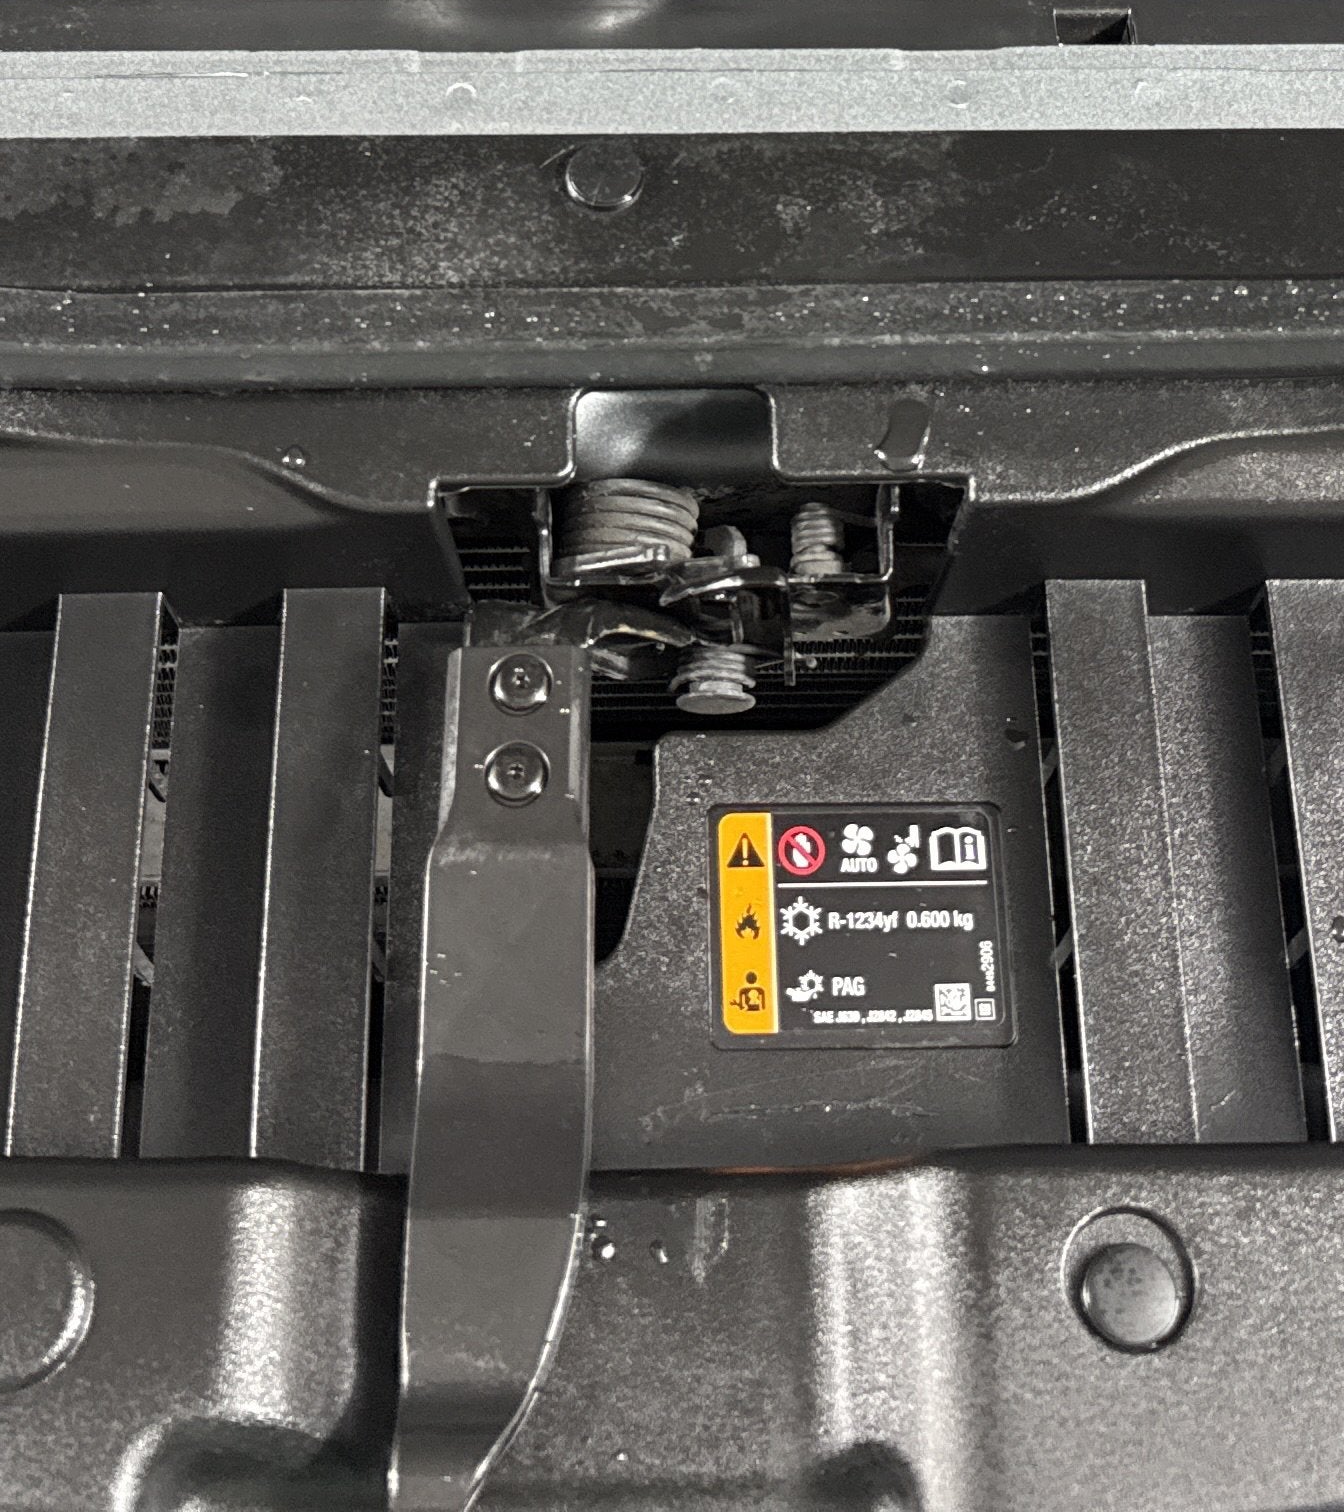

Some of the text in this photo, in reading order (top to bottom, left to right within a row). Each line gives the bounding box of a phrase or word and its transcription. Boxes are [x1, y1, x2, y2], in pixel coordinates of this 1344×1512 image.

[840, 857, 878, 873] AUTO
[827, 909, 975, 932] R-1234yf 0.600 kg
[832, 976, 866, 997] PAG
